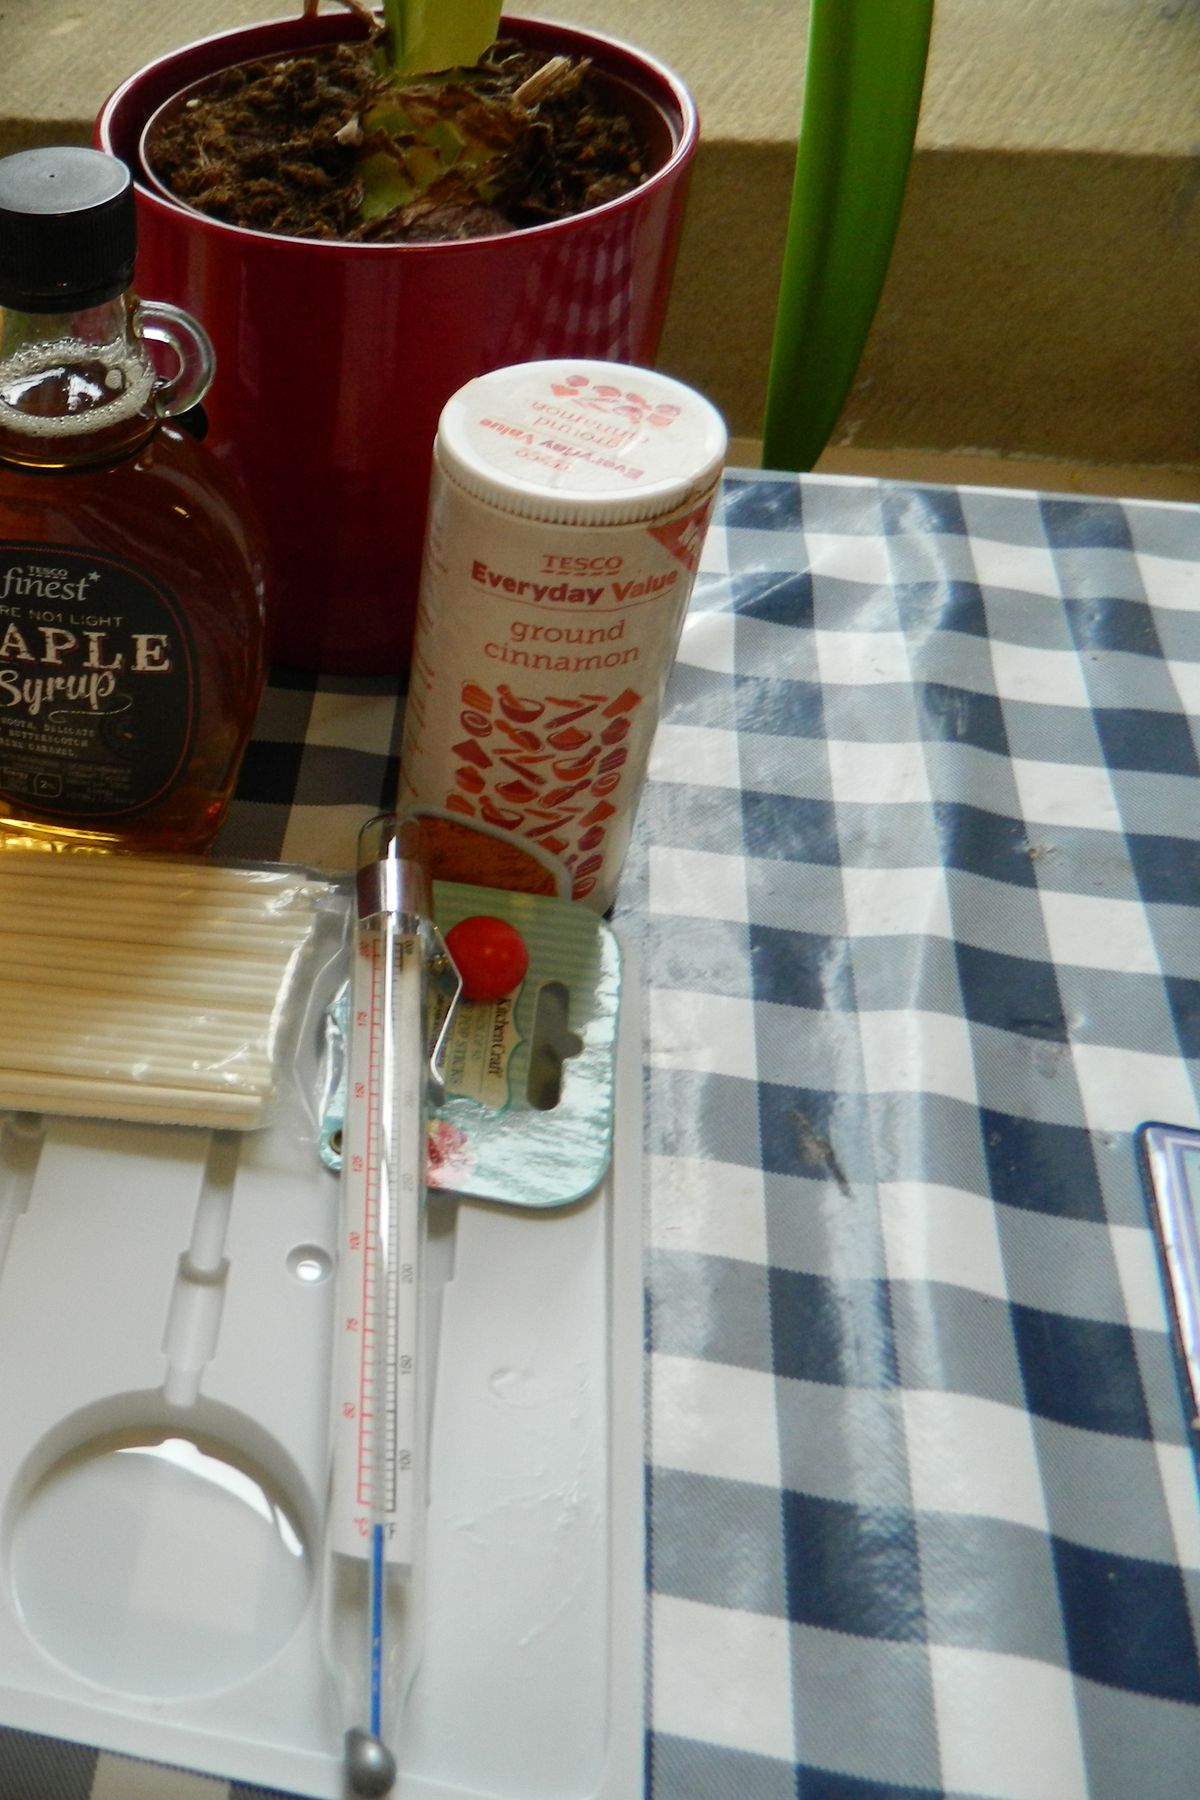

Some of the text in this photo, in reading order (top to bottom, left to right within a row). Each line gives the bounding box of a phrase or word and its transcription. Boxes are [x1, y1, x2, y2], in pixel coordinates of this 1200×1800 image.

[538, 439, 646, 481] Everyday
[27, 565, 69, 579] TESCO
[541, 554, 624, 571] TESCO
[471, 559, 679, 605] Everyday Value
[70, 613, 124, 628] LIGHT
[509, 619, 626, 643] ground
[483, 642, 641, 672] cinnamon
